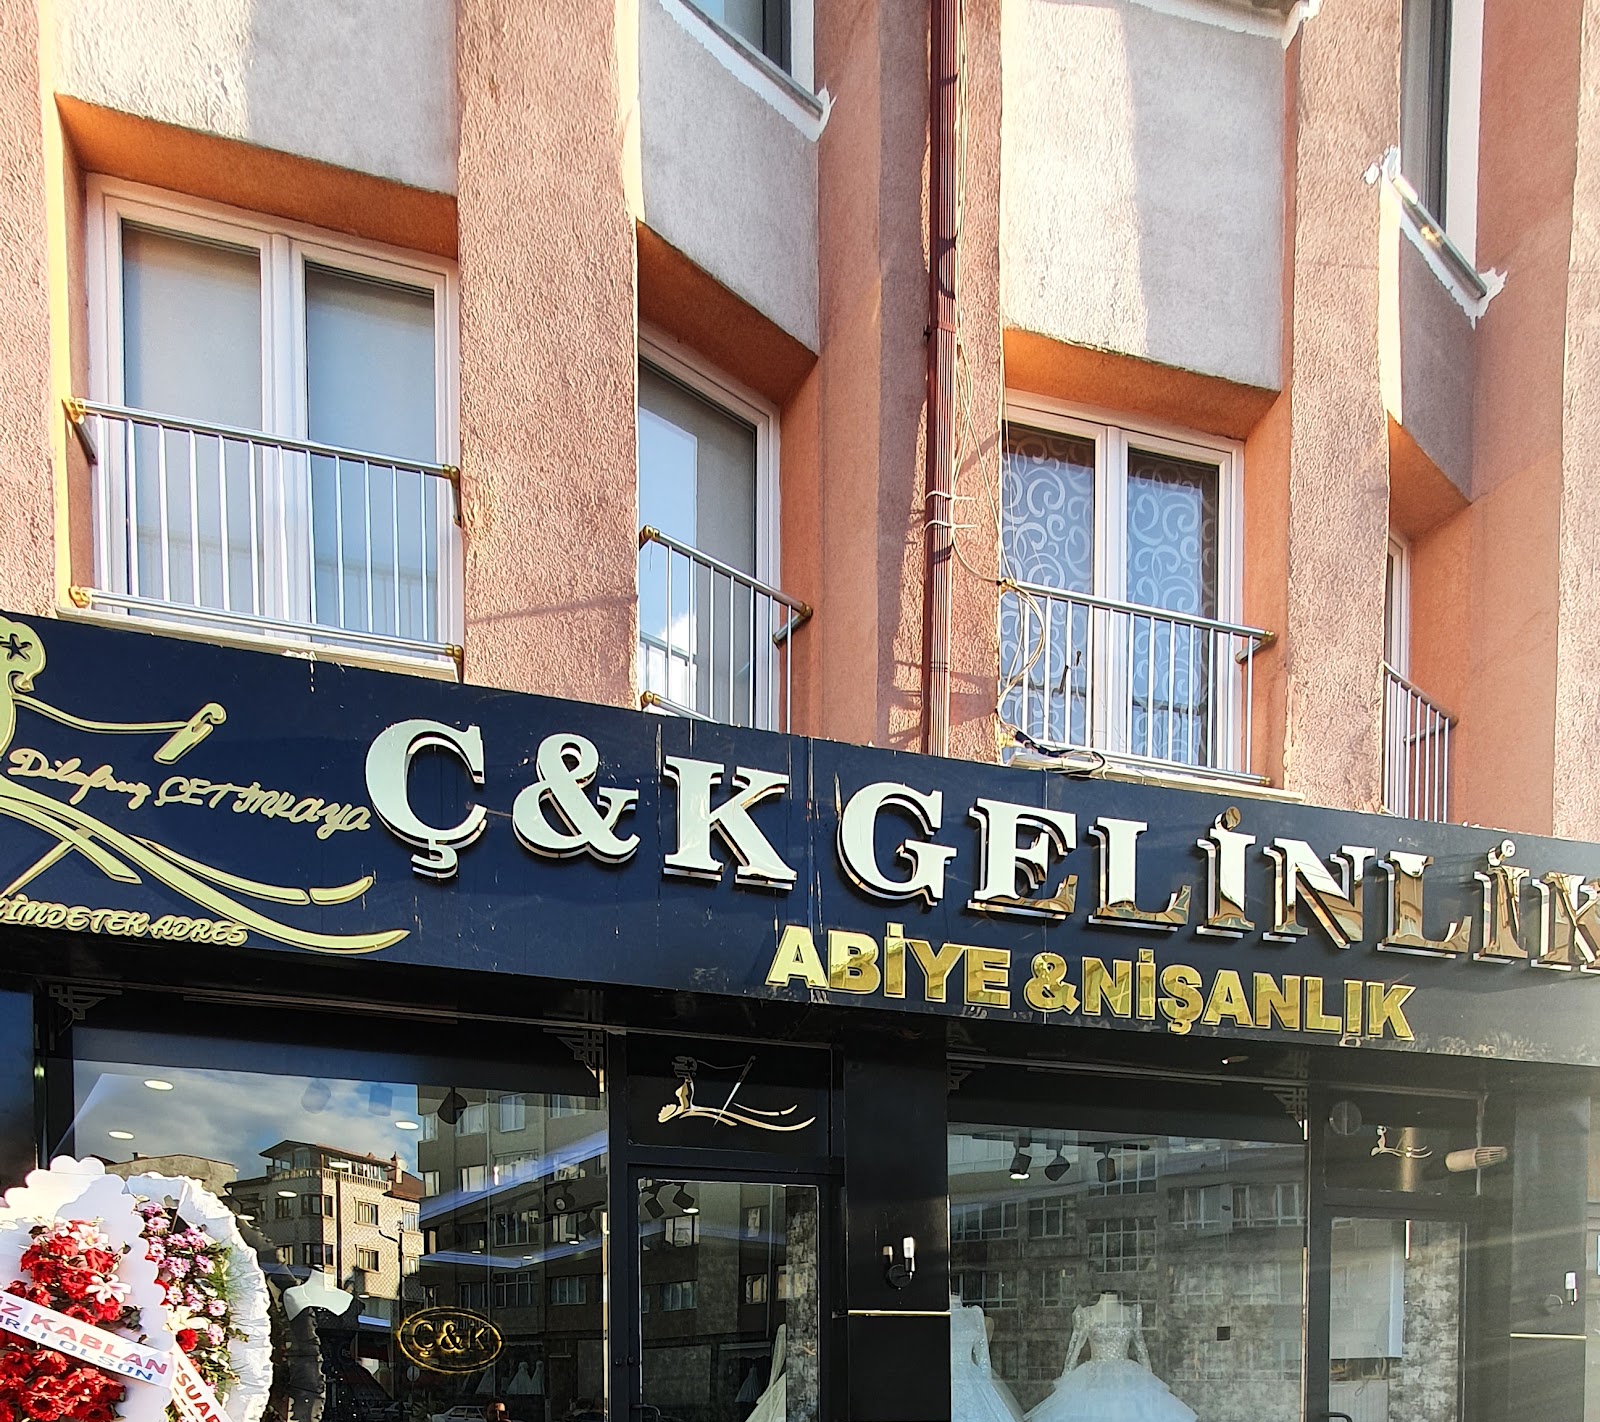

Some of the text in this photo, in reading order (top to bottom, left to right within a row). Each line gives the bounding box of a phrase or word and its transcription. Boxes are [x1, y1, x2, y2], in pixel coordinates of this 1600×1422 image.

[836, 782, 1600, 975] GELİNLİK
[150, 914, 249, 946] ADRES
[765, 922, 1012, 1009] ABİYE
[58, 1340, 153, 1380] OLSUN
